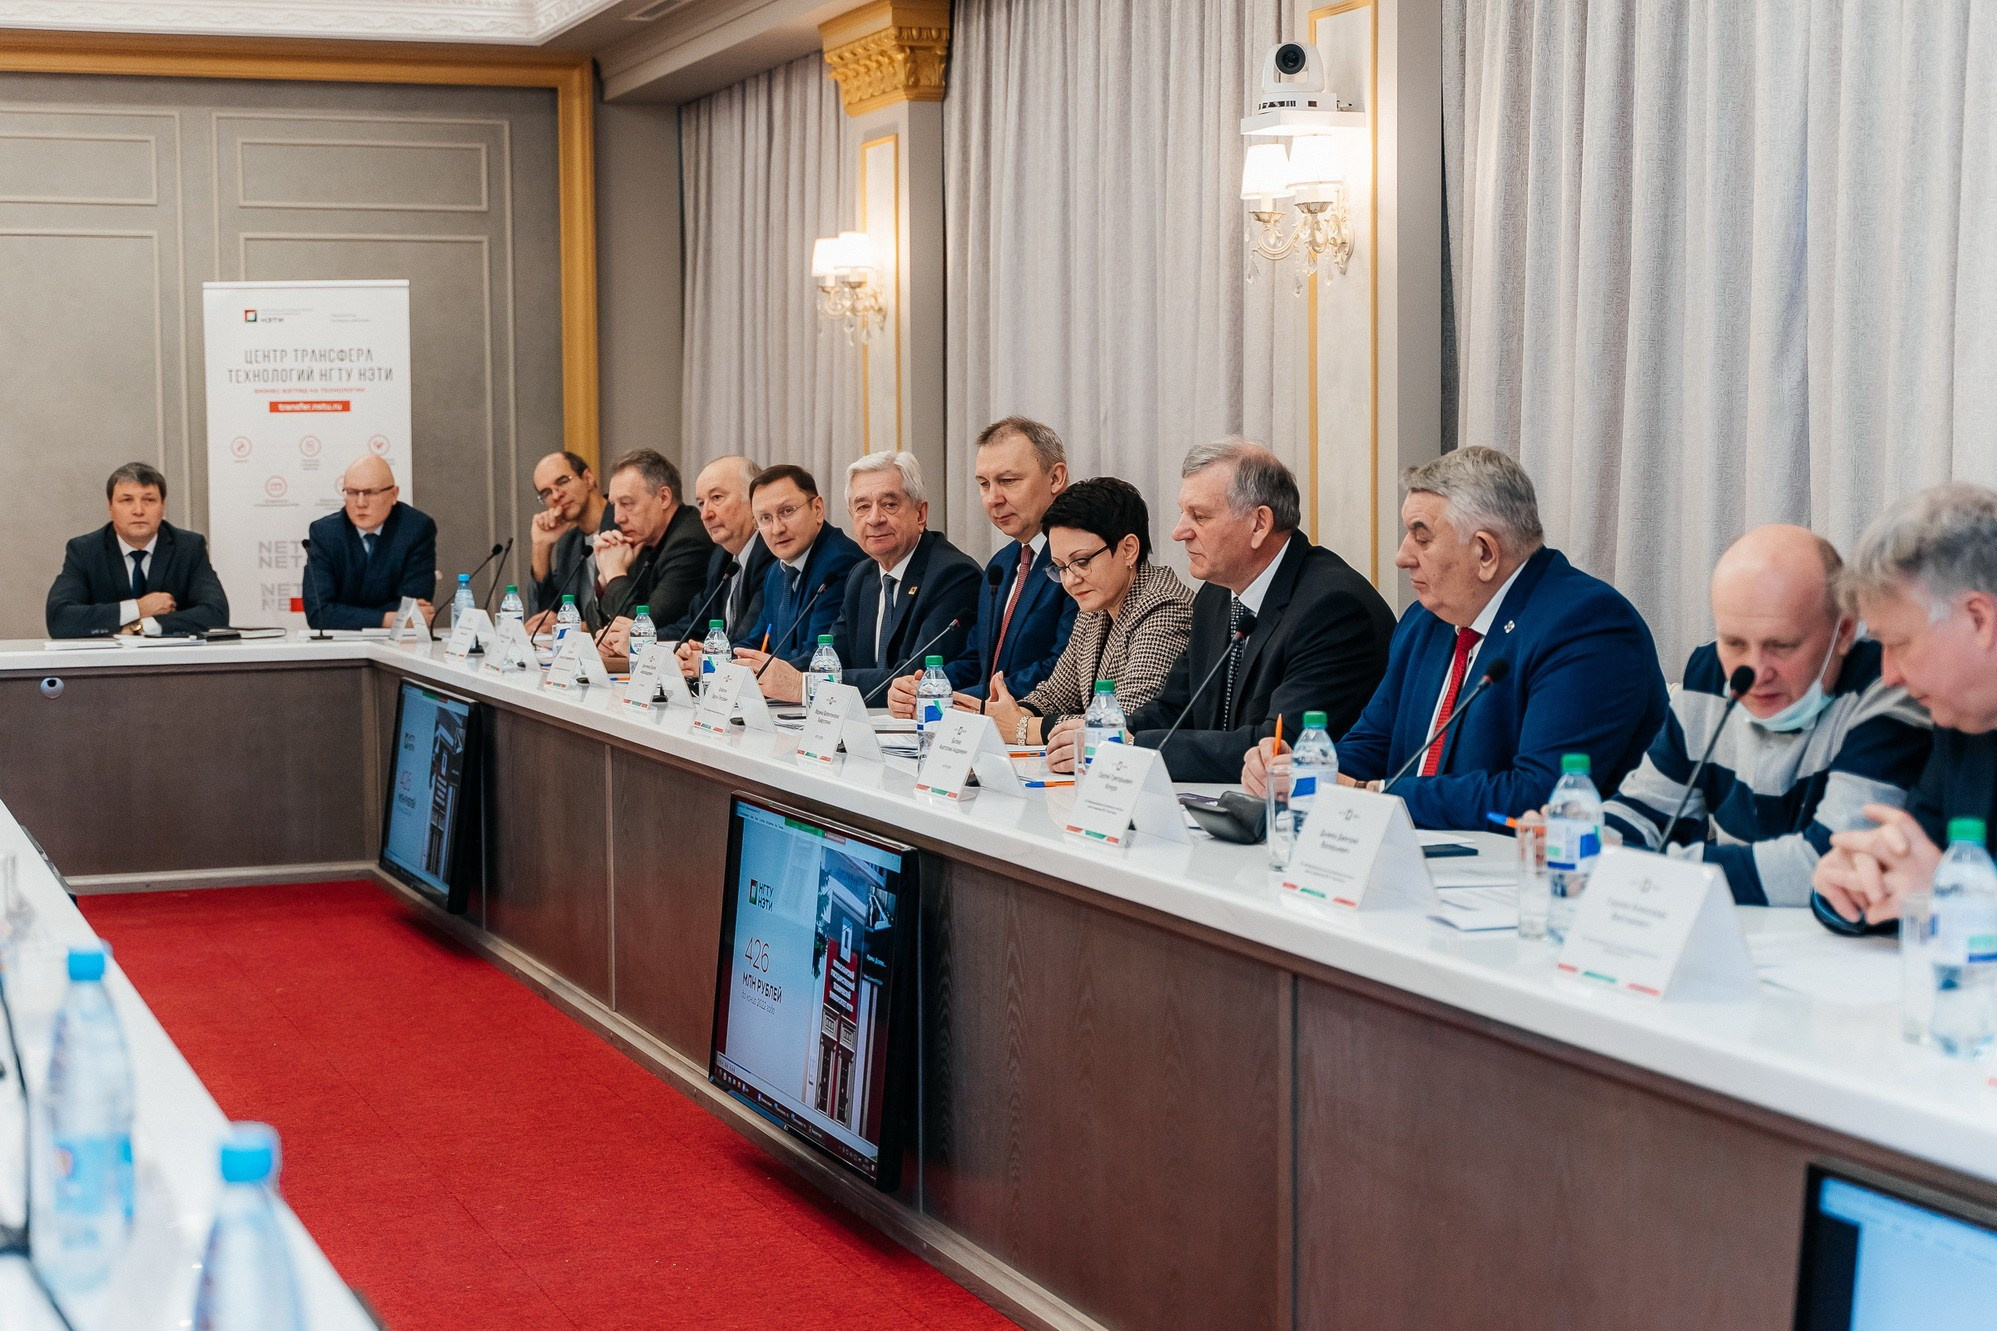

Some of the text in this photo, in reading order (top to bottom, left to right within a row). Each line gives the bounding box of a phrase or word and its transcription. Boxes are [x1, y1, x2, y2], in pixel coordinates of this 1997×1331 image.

[244, 348, 374, 365] ЦЕНТР ТРАНСФЕРА
[228, 366, 394, 384] ТЕХНОЛОГИЙ НГТУ НЭТИ
[759, 882, 774, 897] НГТУ
[757, 896, 773, 911] НЭТИ
[745, 937, 769, 973] 426
[742, 972, 782, 1003] МЛН РУБЛЕЙ
